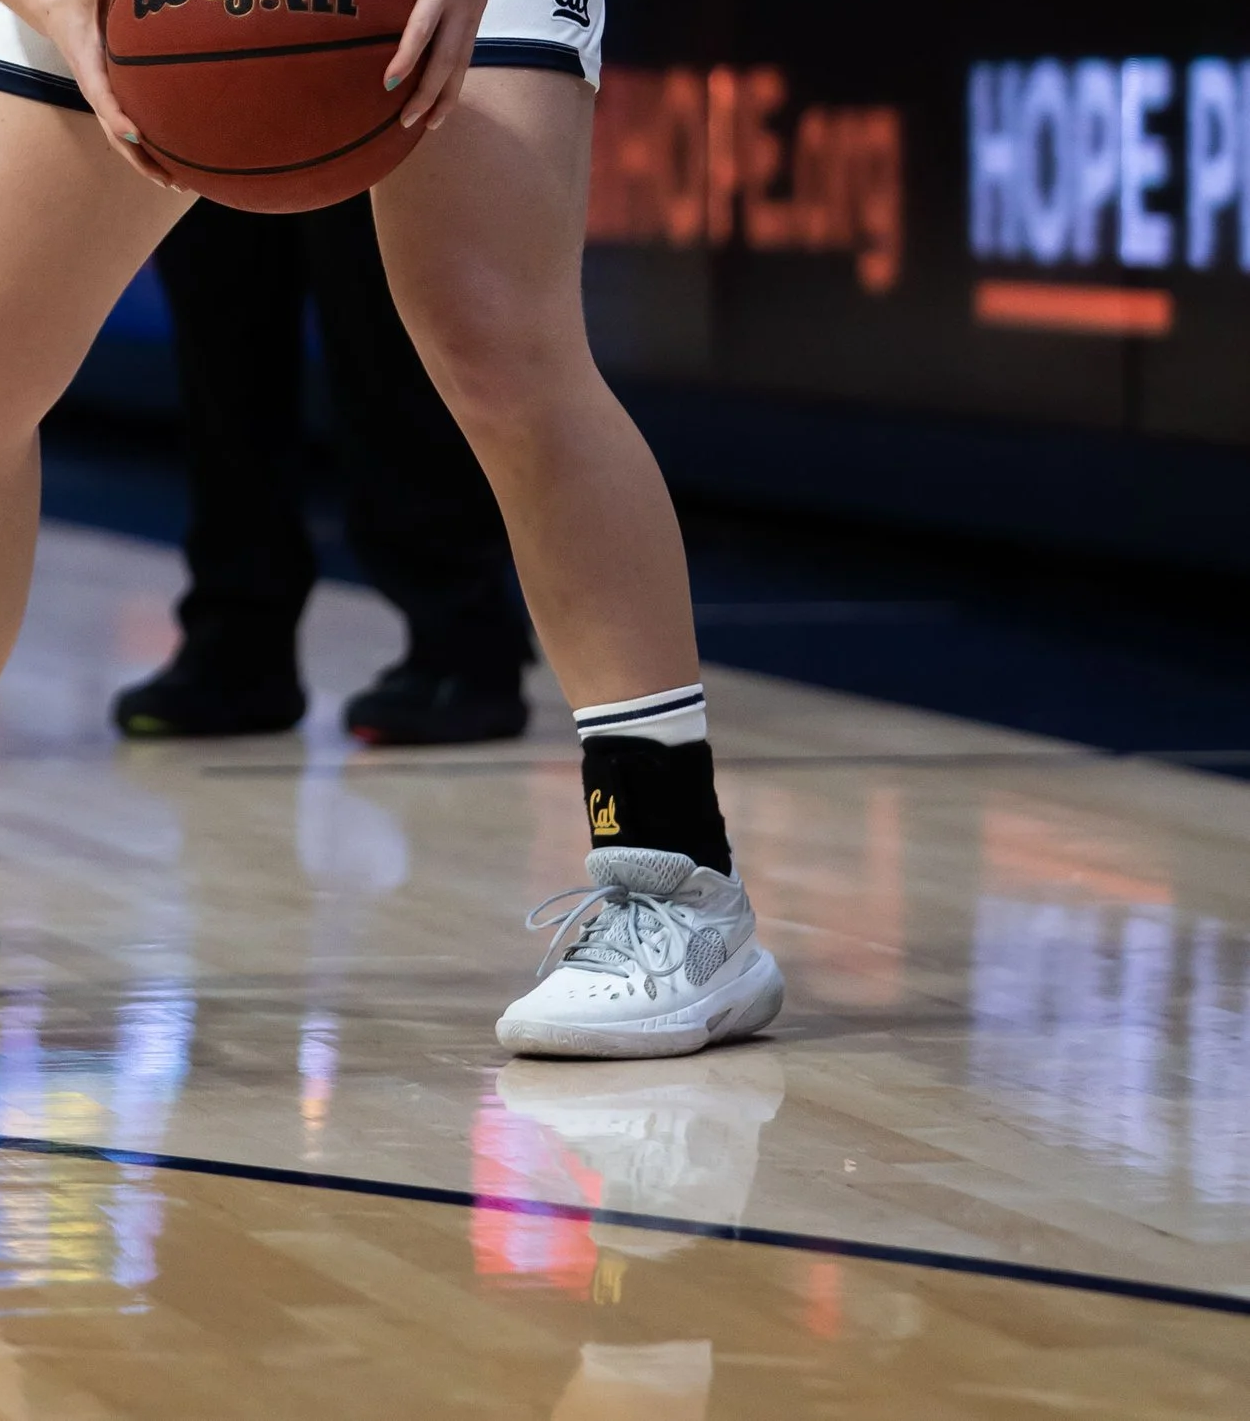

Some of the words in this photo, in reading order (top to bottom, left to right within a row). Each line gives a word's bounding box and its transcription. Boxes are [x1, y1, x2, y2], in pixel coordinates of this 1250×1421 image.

[588, 65, 902, 293] HOPE.org
[966, 56, 1174, 269] HOPE
[589, 788, 620, 836] Cal
